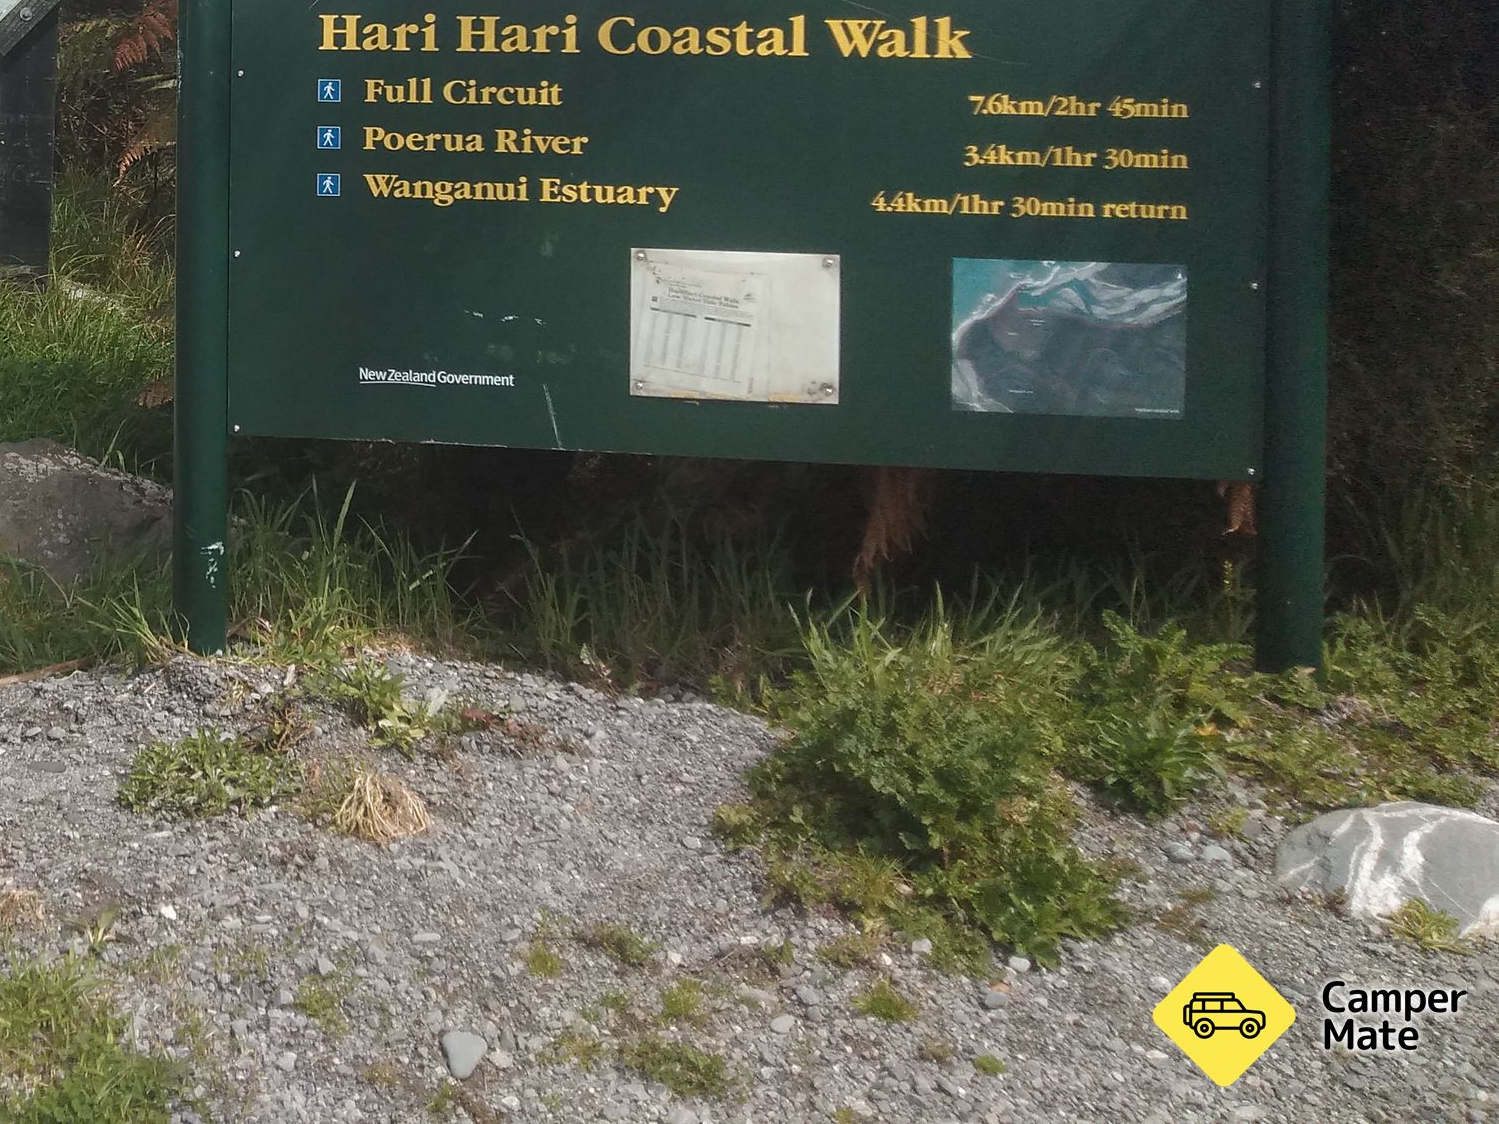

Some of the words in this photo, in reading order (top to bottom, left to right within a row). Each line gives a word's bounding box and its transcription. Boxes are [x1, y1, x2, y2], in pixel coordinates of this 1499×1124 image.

[318, 13, 439, 52] Hari
[455, 14, 581, 54] Hari
[598, 14, 809, 57] Coastal
[825, 15, 973, 60] Walk
[364, 78, 433, 105] Full
[443, 80, 563, 107] Circuit
[968, 92, 1102, 117] 7.6km/2hr
[1106, 95, 1190, 119] 45min
[362, 126, 485, 153] Poerua
[494, 129, 589, 155] River
[963, 143, 1098, 168] 3.4km/1hr
[1103, 148, 1190, 170] 30min
[364, 174, 529, 207] Wanganui
[539, 178, 679, 213] Estuary
[870, 191, 1005, 217] 4.4km/1hr
[1011, 196, 1096, 218] 30min
[1102, 201, 1189, 220] return
[437, 371, 514, 386] Government
